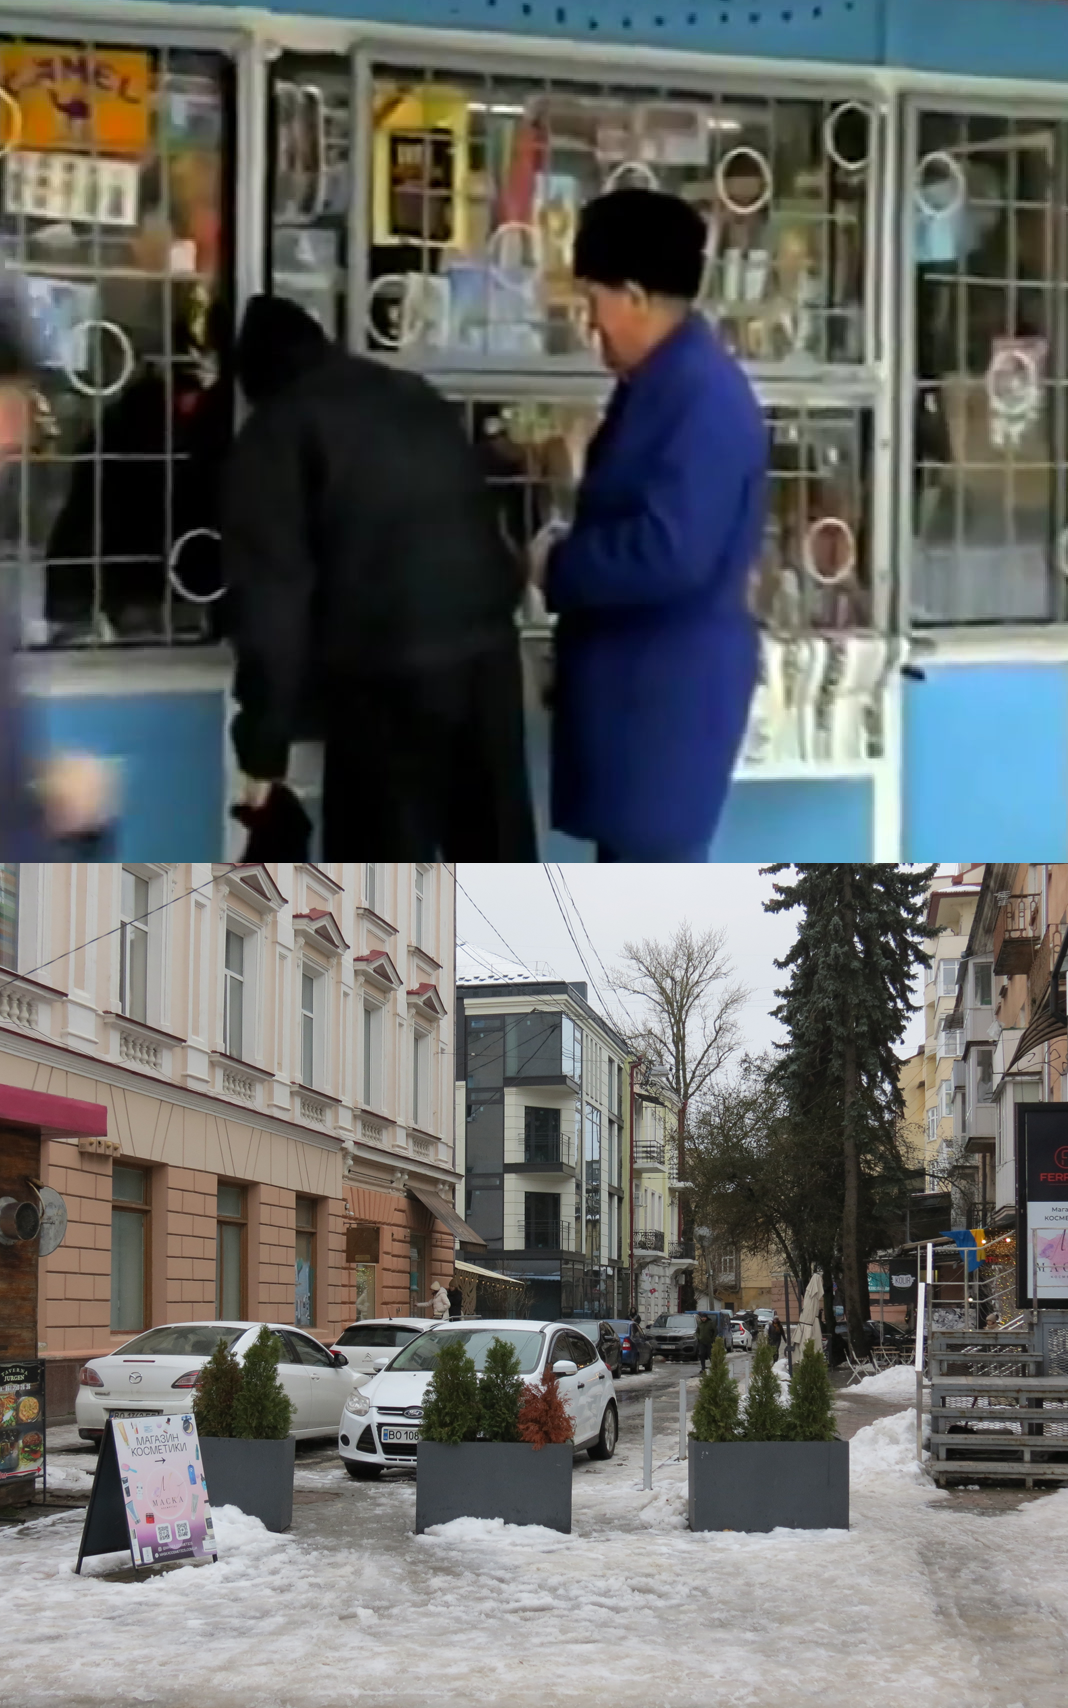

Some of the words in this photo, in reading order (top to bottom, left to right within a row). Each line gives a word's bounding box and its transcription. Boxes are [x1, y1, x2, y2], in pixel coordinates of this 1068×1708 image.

[1, 1368, 28, 1377] TAVERNA
[136, 1433, 179, 1446] МАГАЗИН
[389, 1431, 402, 1440] BO
[131, 1442, 187, 1457] КОСМЕТИКИ
